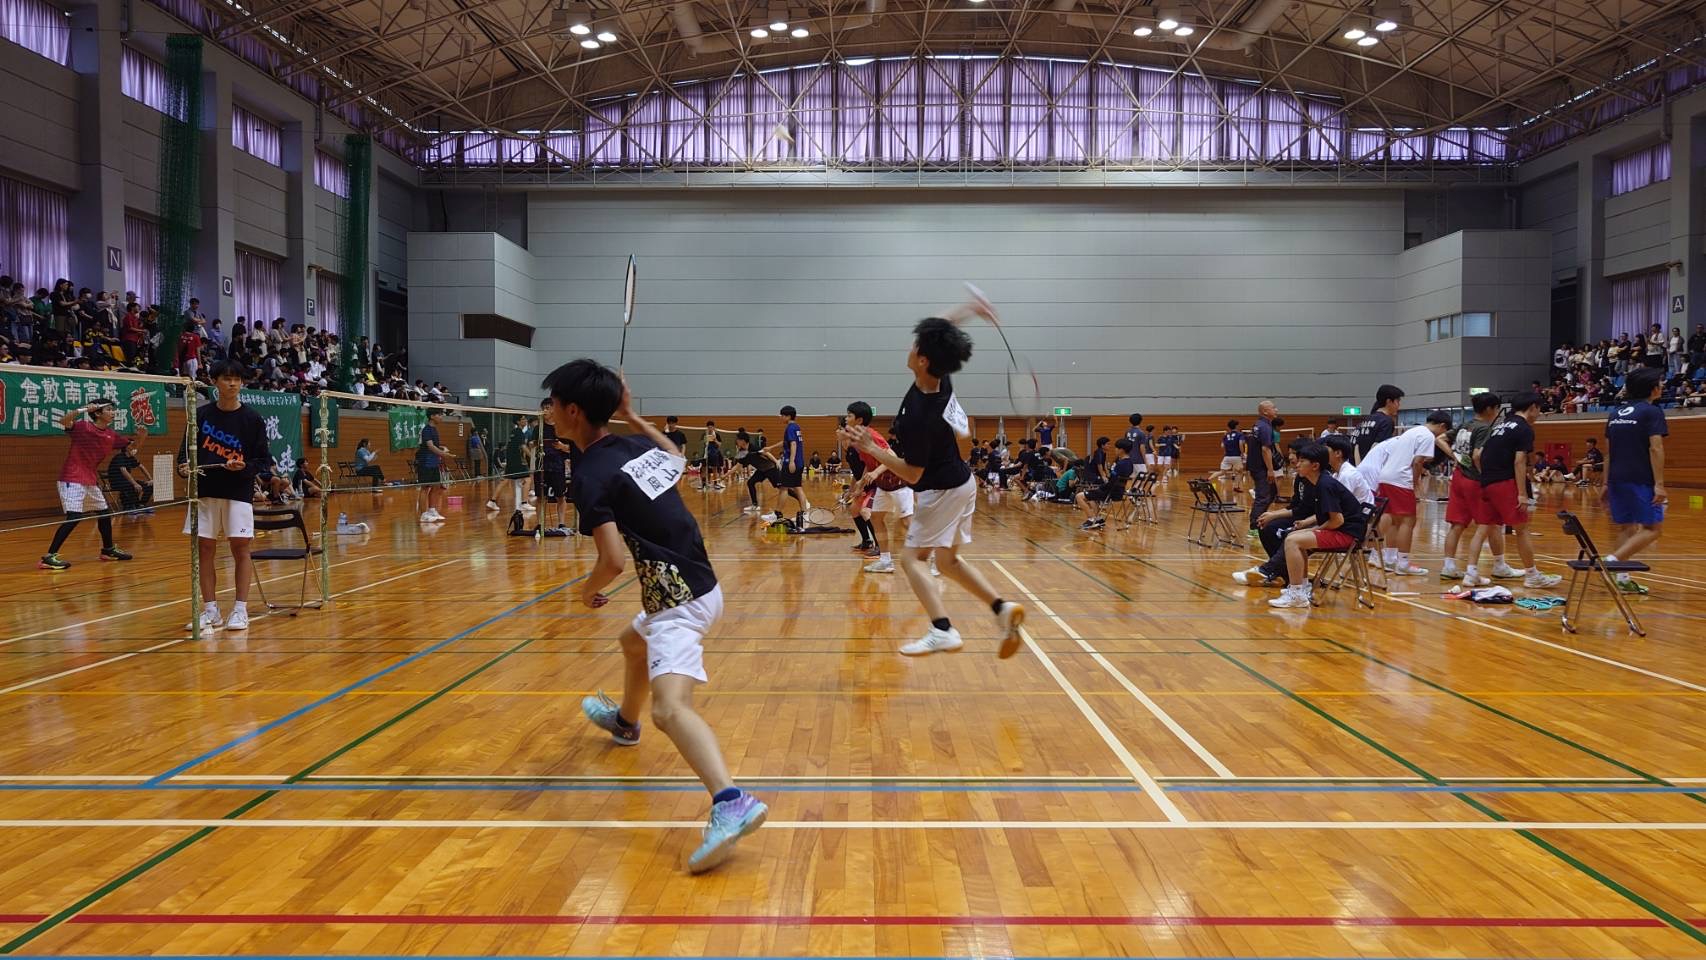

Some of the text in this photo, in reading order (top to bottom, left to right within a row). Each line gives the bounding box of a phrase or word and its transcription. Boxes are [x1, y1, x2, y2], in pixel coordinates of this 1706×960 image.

[110, 249, 120, 268] N
[308, 300, 314, 313] P
[1673, 297, 1683, 311] A
[20, 376, 120, 405] 倉敷南高校
